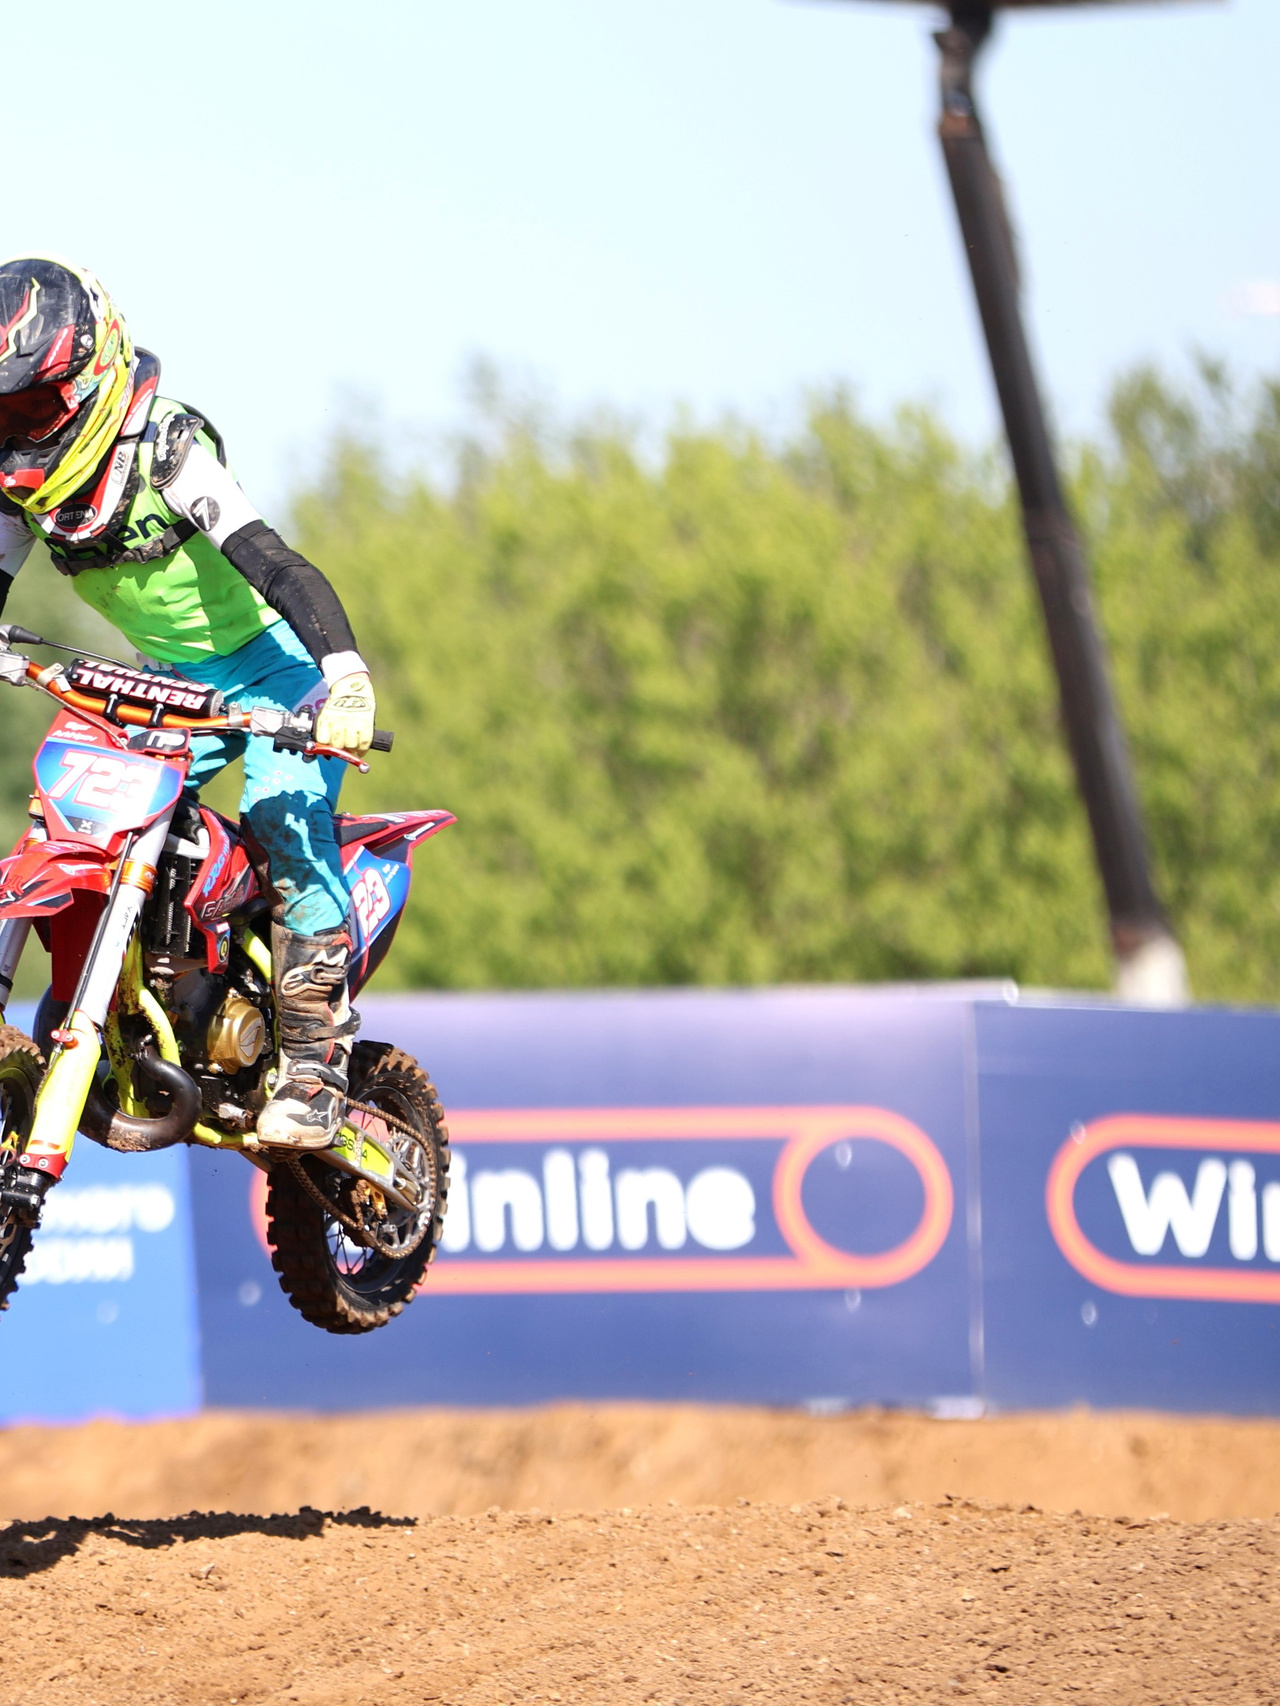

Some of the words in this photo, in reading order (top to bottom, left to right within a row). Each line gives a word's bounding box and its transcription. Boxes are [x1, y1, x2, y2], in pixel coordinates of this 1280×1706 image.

[76, 668, 208, 710] RENTHAL
[47, 750, 157, 812] 723
[332, 1147, 756, 1252] inline
